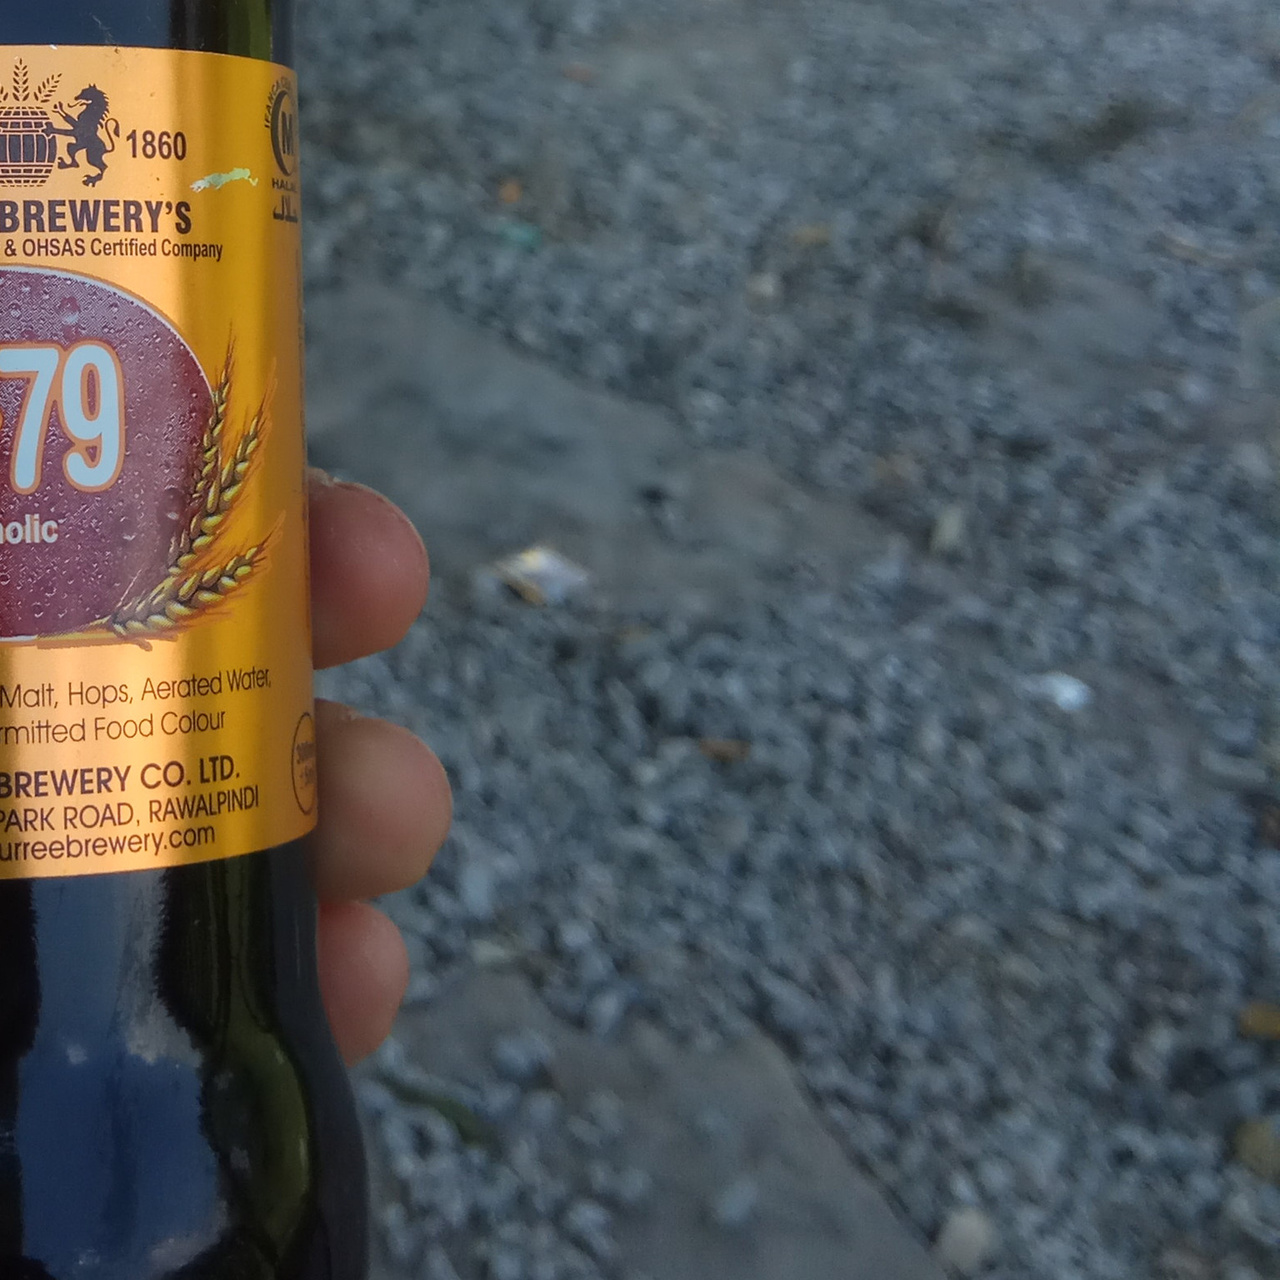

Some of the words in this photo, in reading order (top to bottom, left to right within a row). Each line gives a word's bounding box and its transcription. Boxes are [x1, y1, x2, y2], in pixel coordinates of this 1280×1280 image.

[125, 130, 186, 160] 1860
[4, 239, 17, 257] &
[22, 238, 85, 257] OHSAS
[90, 237, 157, 257] Certified
[161, 237, 223, 262] Company
[0, 683, 59, 709] Malt,
[68, 681, 134, 709] Hops,
[141, 671, 222, 701] Aerated
[94, 713, 154, 741] Food
[160, 709, 226, 736] Colour
[140, 760, 192, 790] CO.
[199, 755, 240, 785] LTD.
[63, 802, 140, 830] ROAD,
[149, 785, 260, 824] RAWALPINDI
